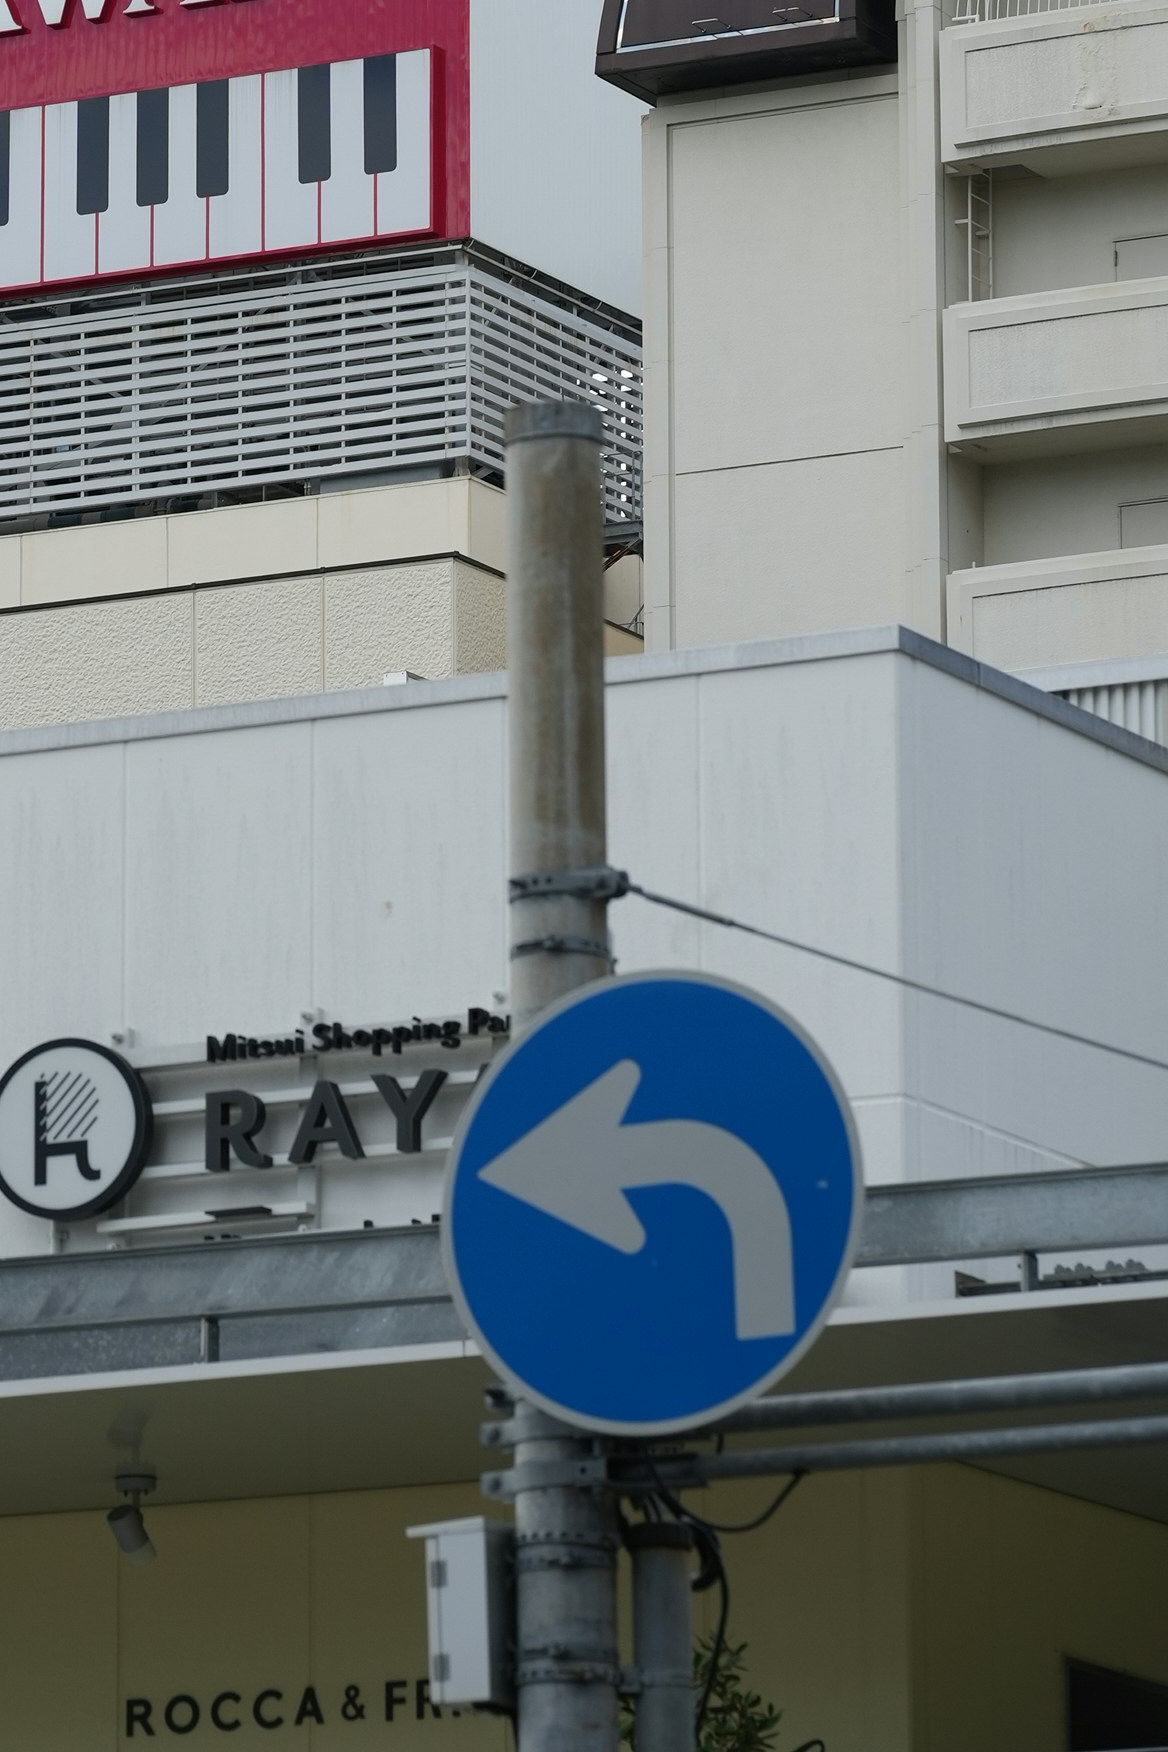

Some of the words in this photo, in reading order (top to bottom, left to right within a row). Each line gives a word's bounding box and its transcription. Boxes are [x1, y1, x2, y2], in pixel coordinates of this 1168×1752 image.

[205, 1028, 304, 1063] Mitsui
[311, 1015, 462, 1056] Shopping
[204, 1063, 488, 1172] RAY
[125, 1686, 325, 1737] ROCCA
[341, 1684, 366, 1722] &
